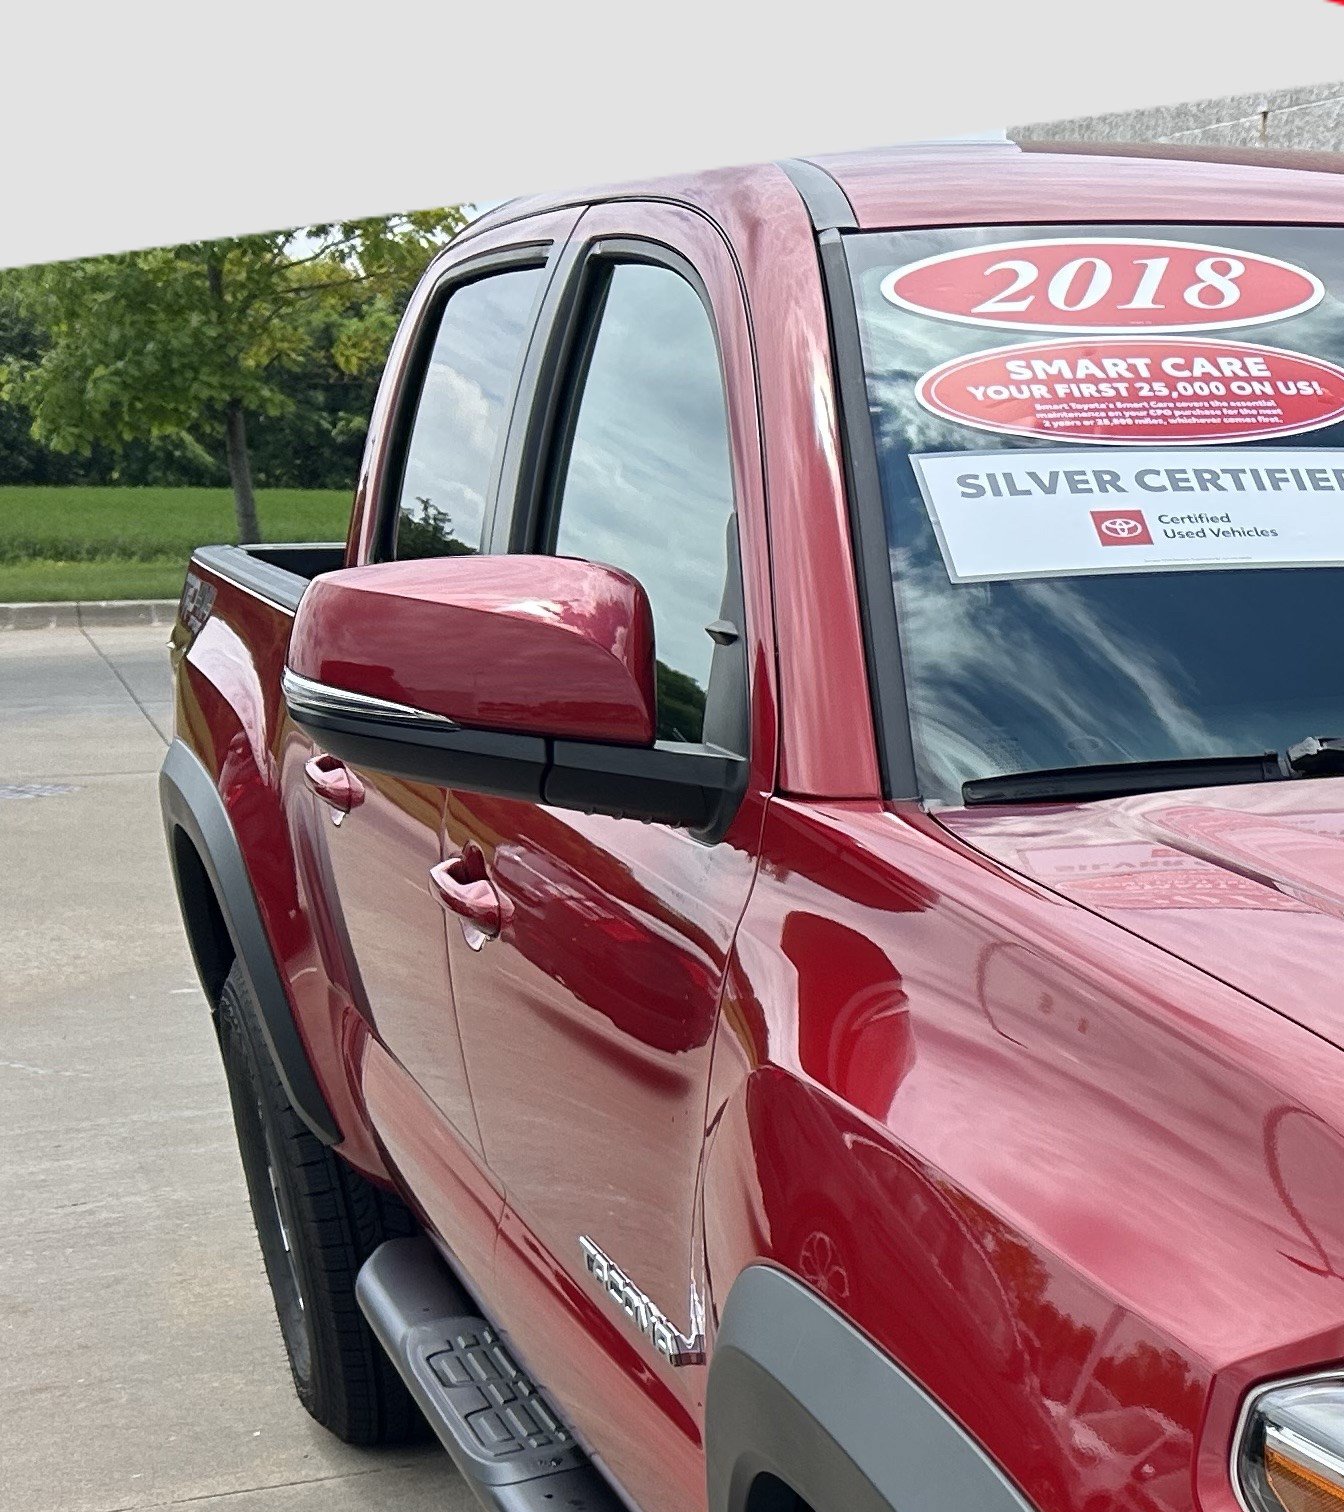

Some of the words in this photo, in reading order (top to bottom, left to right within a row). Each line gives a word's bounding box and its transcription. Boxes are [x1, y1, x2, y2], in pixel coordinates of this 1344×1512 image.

[972, 257, 1246, 314] 2018
[1006, 357, 1151, 380] SMART
[1161, 357, 1272, 379] CARE
[966, 383, 1052, 401] YOUR
[1054, 382, 1129, 399] FIRST
[1135, 381, 1226, 399] 25,000
[1230, 380, 1275, 397] ON
[1275, 379, 1324, 397] US!
[956, 468, 1130, 498] SILVER
[1158, 511, 1231, 525] Certified
[1163, 527, 1207, 540] Used
[1209, 525, 1278, 539] Vehicles
